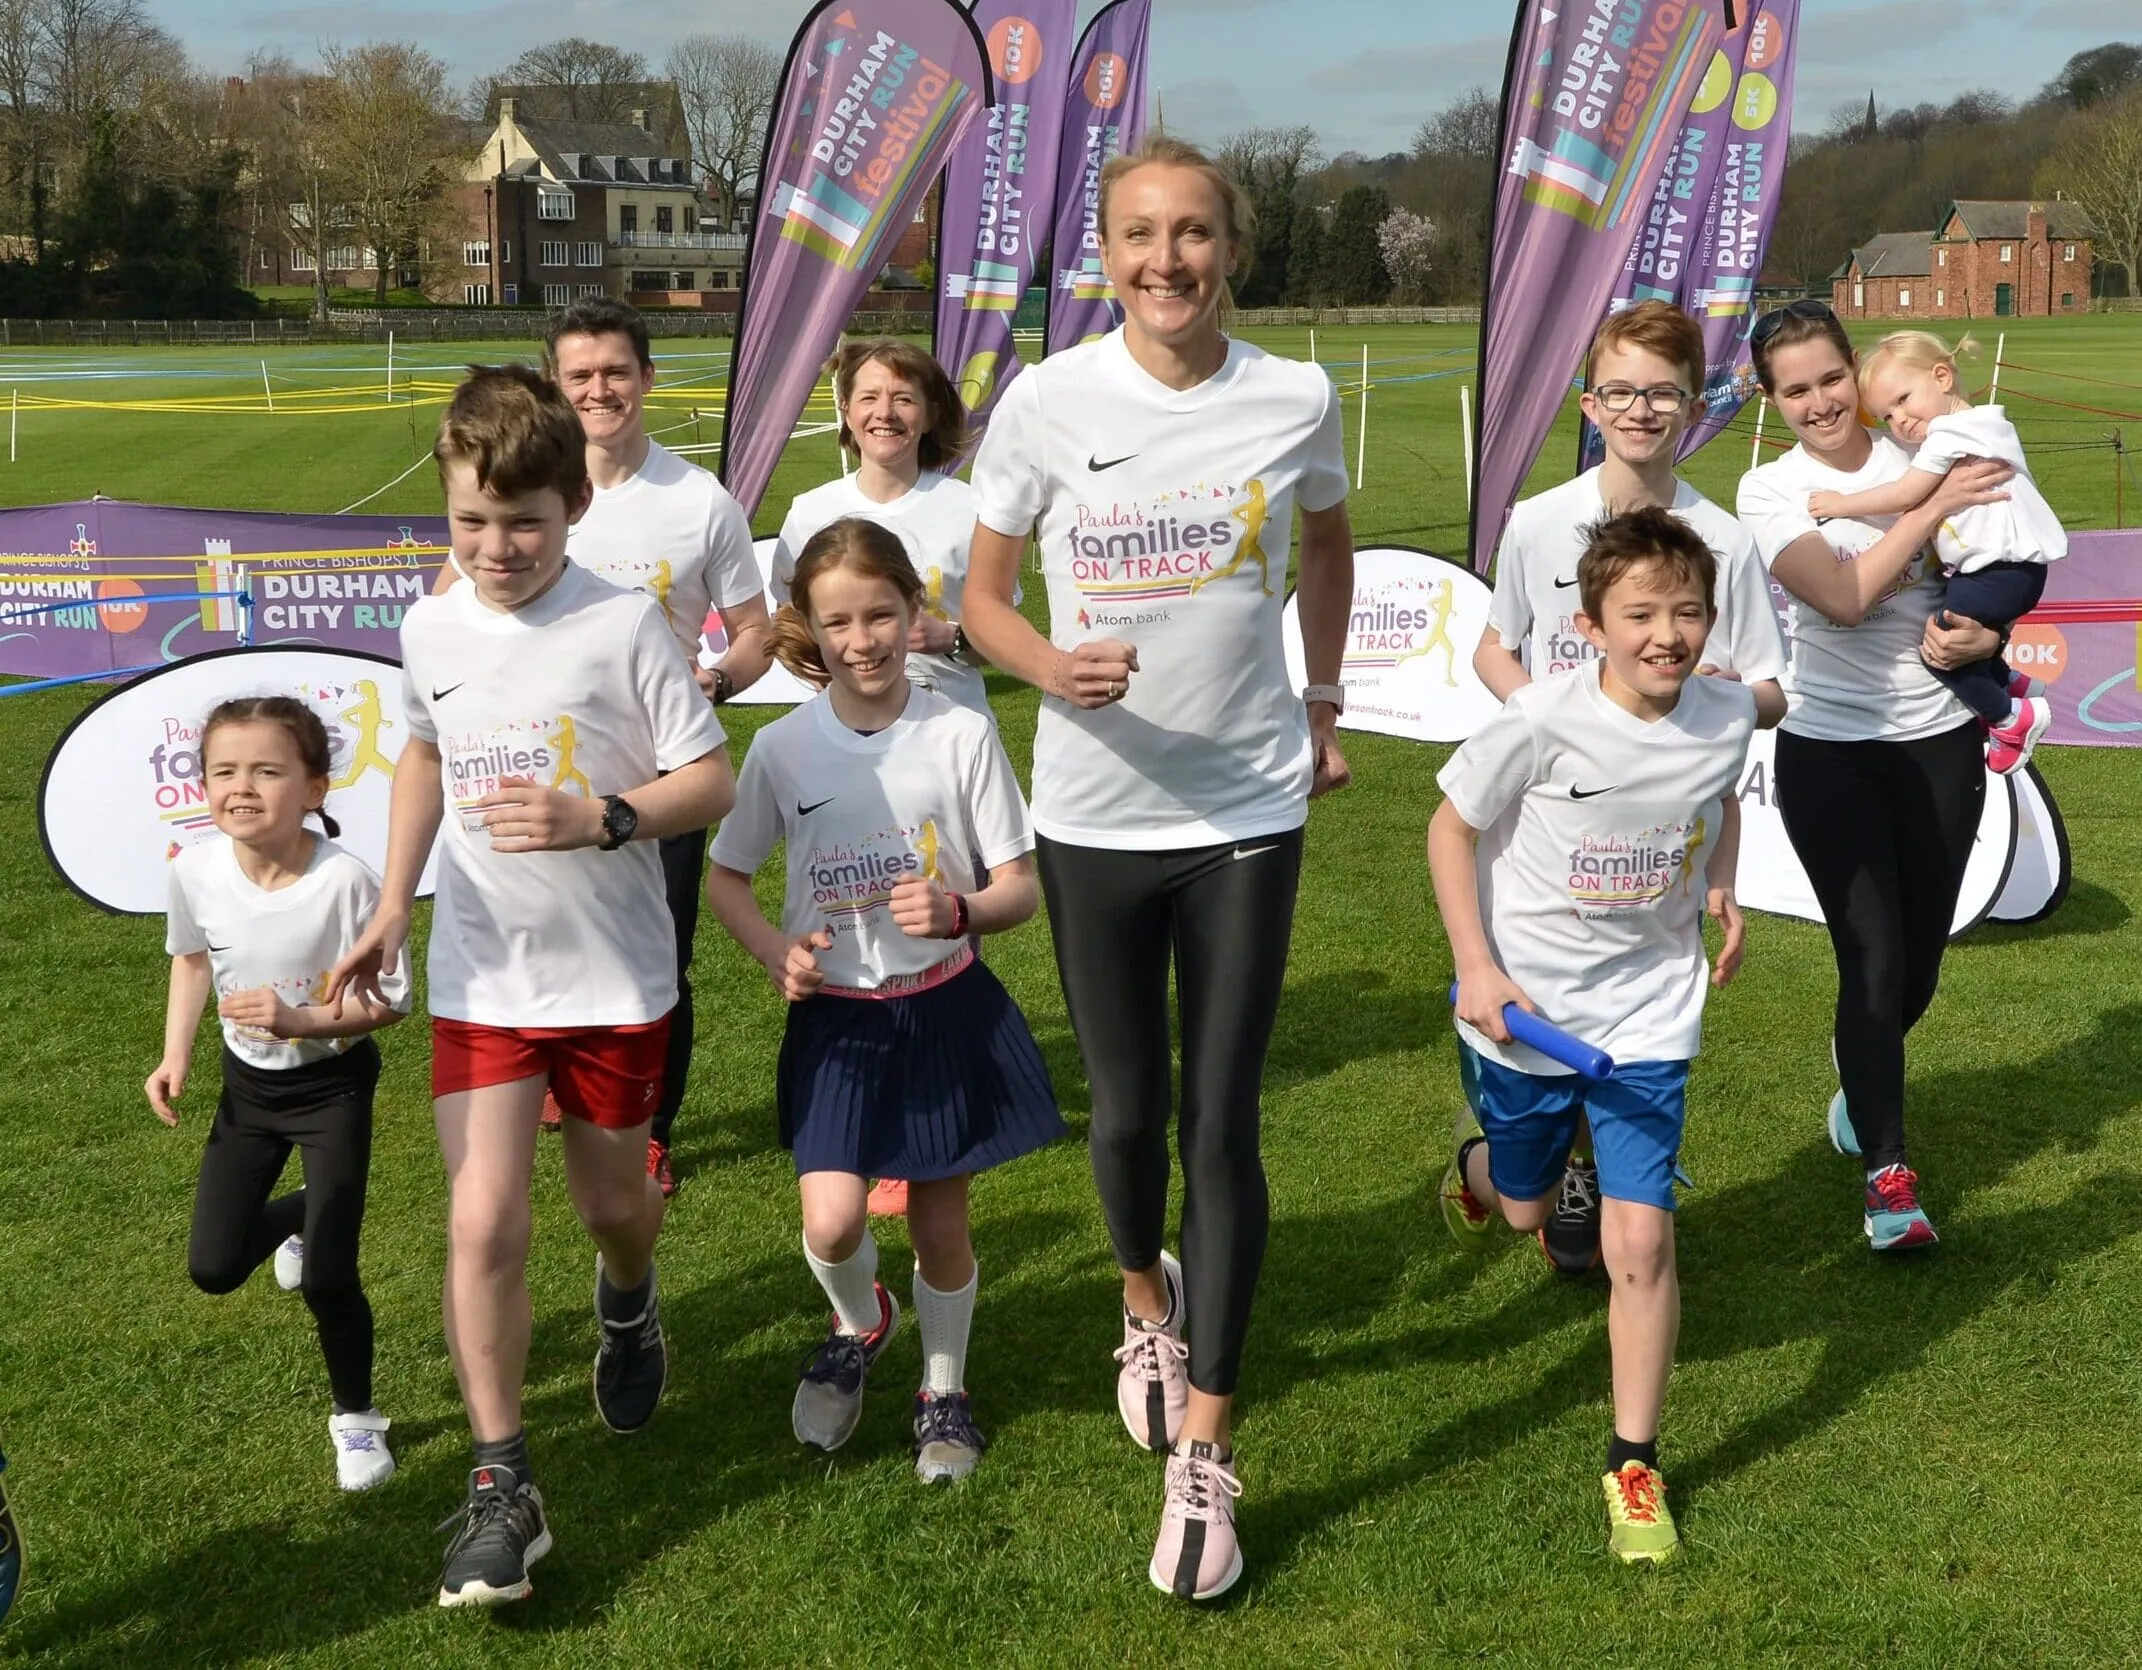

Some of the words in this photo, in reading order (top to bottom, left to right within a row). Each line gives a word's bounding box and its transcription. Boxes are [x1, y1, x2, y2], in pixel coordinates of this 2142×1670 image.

[1005, 24, 1024, 76] 10K
[1750, 17, 1769, 63] 10K
[1099, 59, 1114, 102] 10K
[1579, 50, 1622, 130] CITY
[1609, 0, 1645, 50] RU
[812, 30, 896, 164] DURHAM
[834, 108, 877, 177] CITY
[870, 43, 919, 110] RUN
[1745, 87, 1760, 118] 5K
[853, 57, 950, 197] festival
[1006, 103, 1030, 175] RUN
[977, 103, 1006, 250] DURHAM
[1082, 125, 1102, 249] DURHAM
[1742, 143, 1763, 202] RUN
[1000, 181, 1022, 255] CITY
[1640, 129, 1684, 273] DURHA
[1657, 205, 1688, 281] CITY
[1673, 127, 1706, 200] RUN
[1717, 144, 1742, 268] DURHAM
[1702, 215, 1716, 267] PRINCE
[1739, 209, 1759, 270] CITY
[1709, 394, 1733, 407] ouncil
[1076, 502, 1144, 529] Paula's
[1068, 517, 1232, 559] families
[331, 554, 402, 568] BISHOPS
[1072, 559, 1109, 581] ON
[1120, 551, 1215, 580] TRACK
[264, 574, 425, 599] DURHAM
[0, 602, 49, 626] CITY
[54, 605, 97, 631] RUN
[263, 604, 345, 630] CITY
[353, 604, 411, 629] RU
[1095, 612, 1133, 627] Atom
[1136, 608, 1172, 625] bank
[1350, 602, 1428, 633] milies
[1357, 632, 1414, 651] TRACK
[2002, 643, 2058, 665] 10K
[813, 843, 856, 865] Paula's
[1569, 846, 1684, 875] families
[1582, 834, 1632, 854] Paula's
[809, 852, 919, 888] families
[1569, 874, 1600, 891] ON
[1610, 871, 1670, 891] TRACK
[813, 887, 840, 903] ON
[844, 877, 896, 899] TRAC
